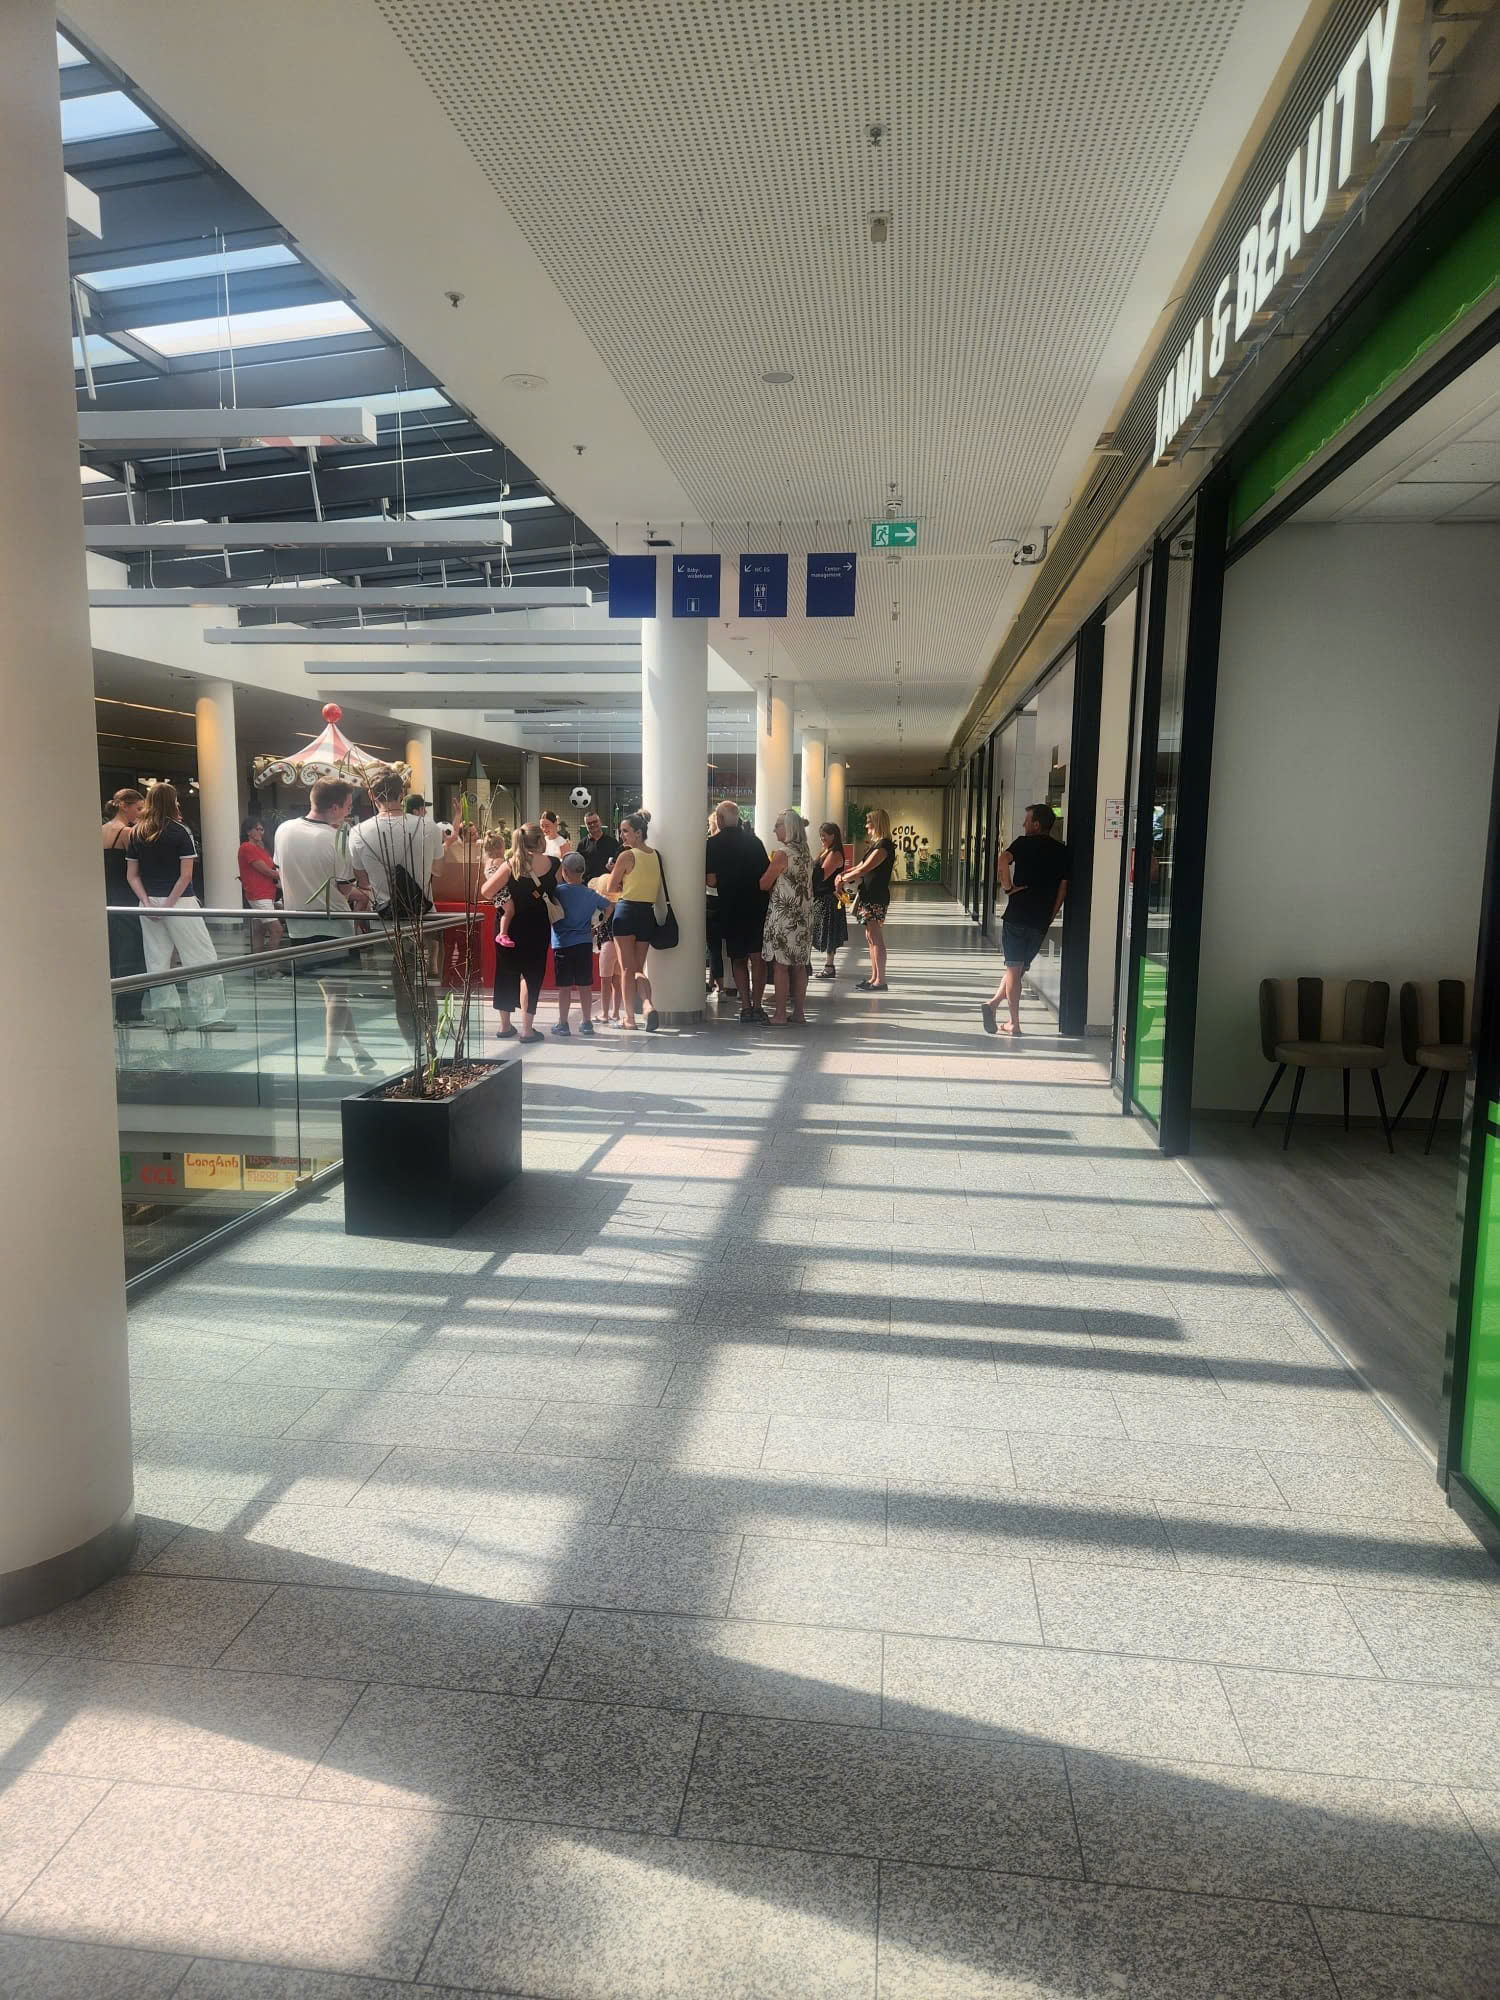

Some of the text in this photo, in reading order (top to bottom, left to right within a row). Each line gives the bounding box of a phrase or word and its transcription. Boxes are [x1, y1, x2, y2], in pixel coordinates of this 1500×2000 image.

[1209, 272, 1233, 378] &
[1235, 0, 1400, 343] BEAUTY
[892, 825, 917, 836] COOL
